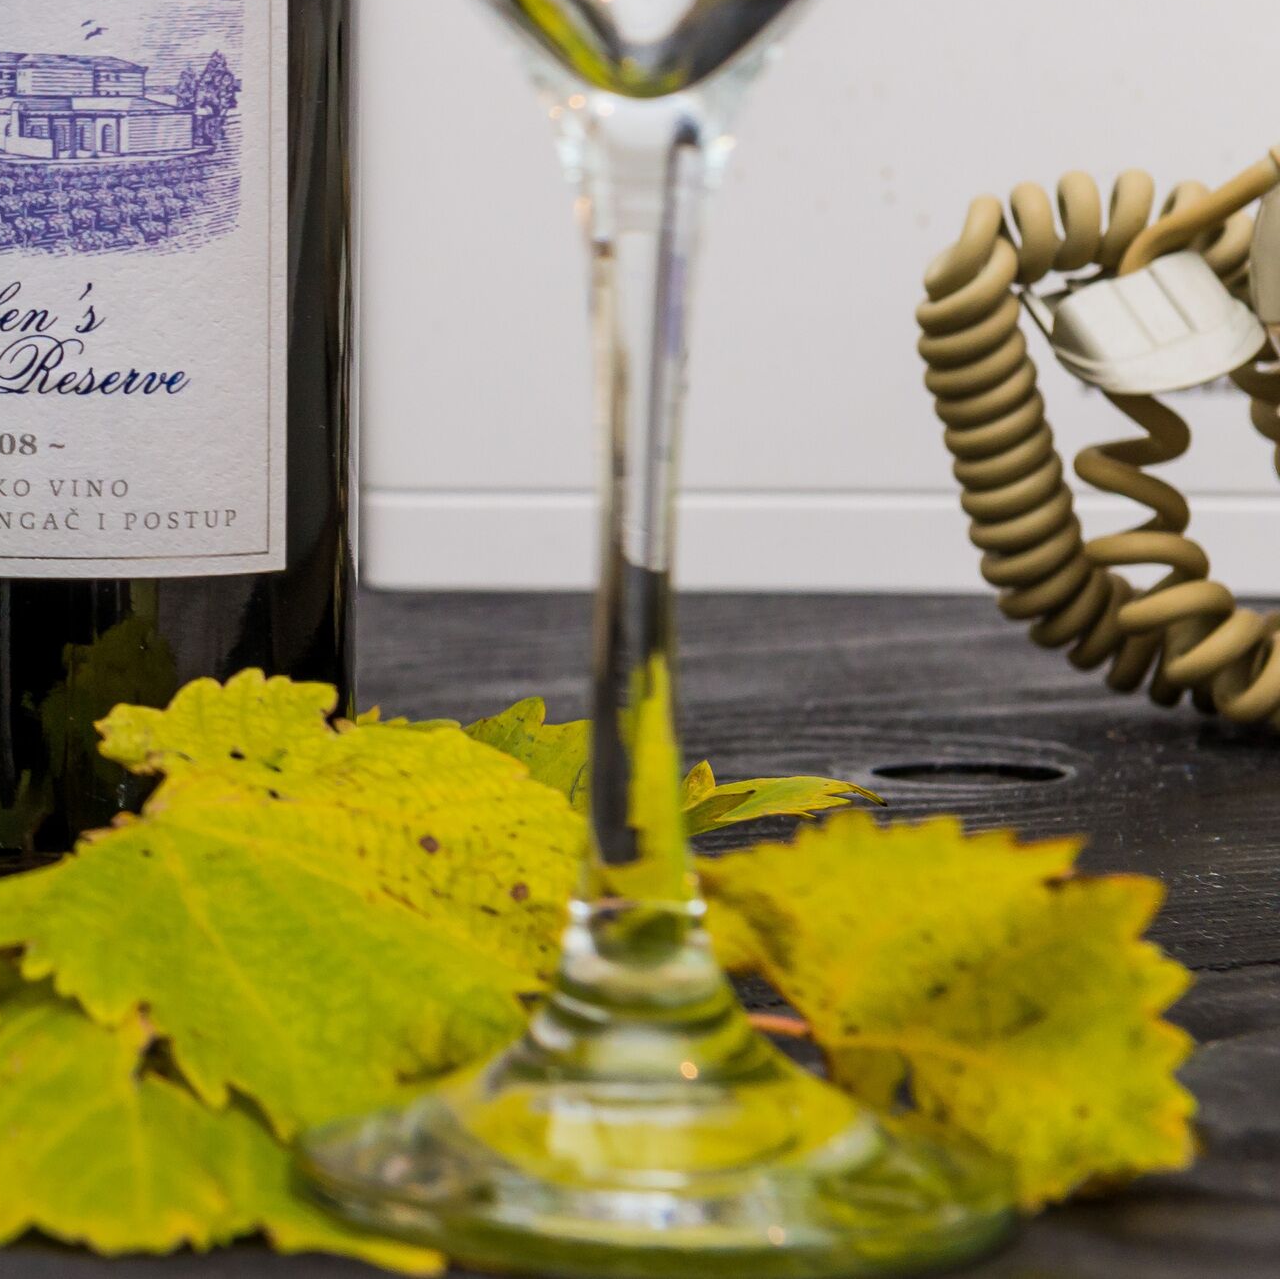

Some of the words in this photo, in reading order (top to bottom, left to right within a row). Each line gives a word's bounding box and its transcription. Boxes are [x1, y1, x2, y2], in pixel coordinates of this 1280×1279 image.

[51, 479, 130, 499] VINO
[98, 512, 106, 531] I
[124, 509, 238, 531] POSTUP
